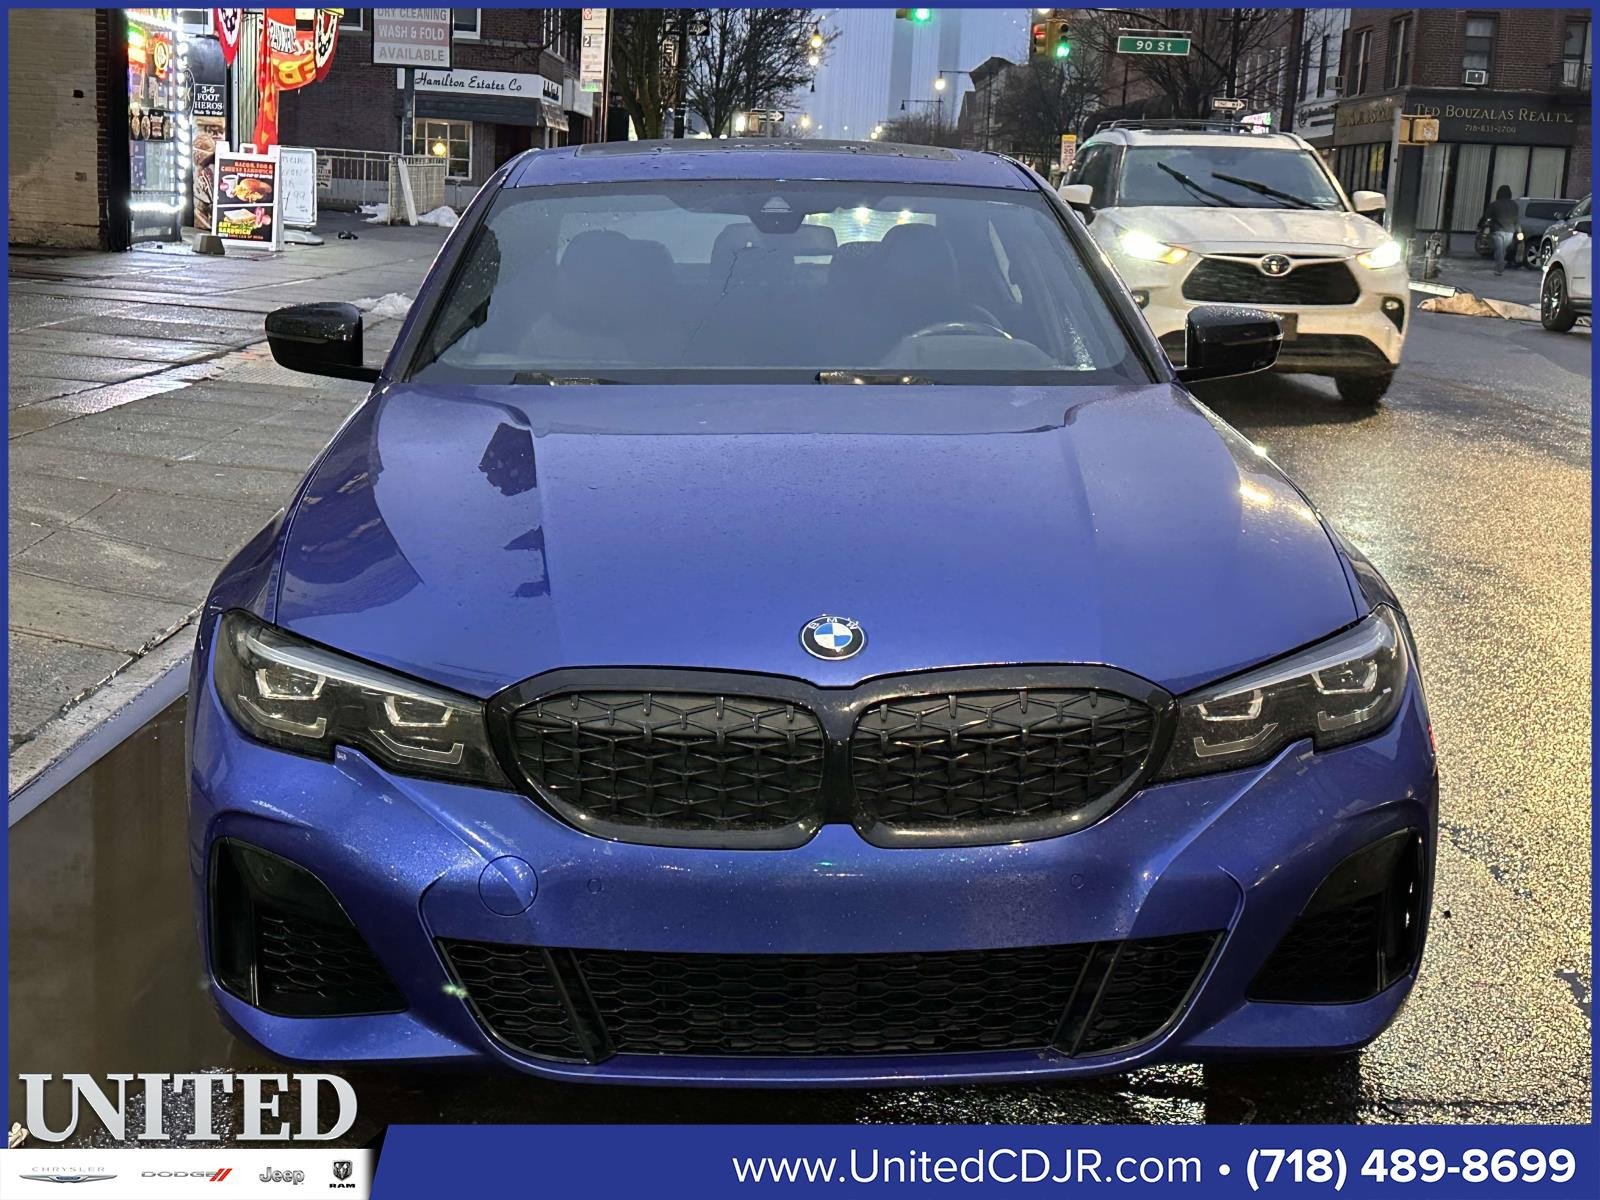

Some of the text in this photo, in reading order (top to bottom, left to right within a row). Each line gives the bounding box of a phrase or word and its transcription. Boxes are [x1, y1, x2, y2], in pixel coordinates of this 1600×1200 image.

[378, 8, 446, 20] DRY CLEANING
[379, 24, 444, 40] WASH & FOLD
[584, 36, 590, 46] 2
[1136, 41, 1172, 51] 90 St
[379, 47, 445, 62] AVAILABLE
[415, 71, 522, 92] Hamilton Estates Co
[202, 86, 215, 94] 3-6
[197, 93, 220, 102] FOOT
[195, 101, 223, 110] HEROS
[1446, 104, 1515, 121] BOUZALAS
[1519, 107, 1574, 123] REALTY
